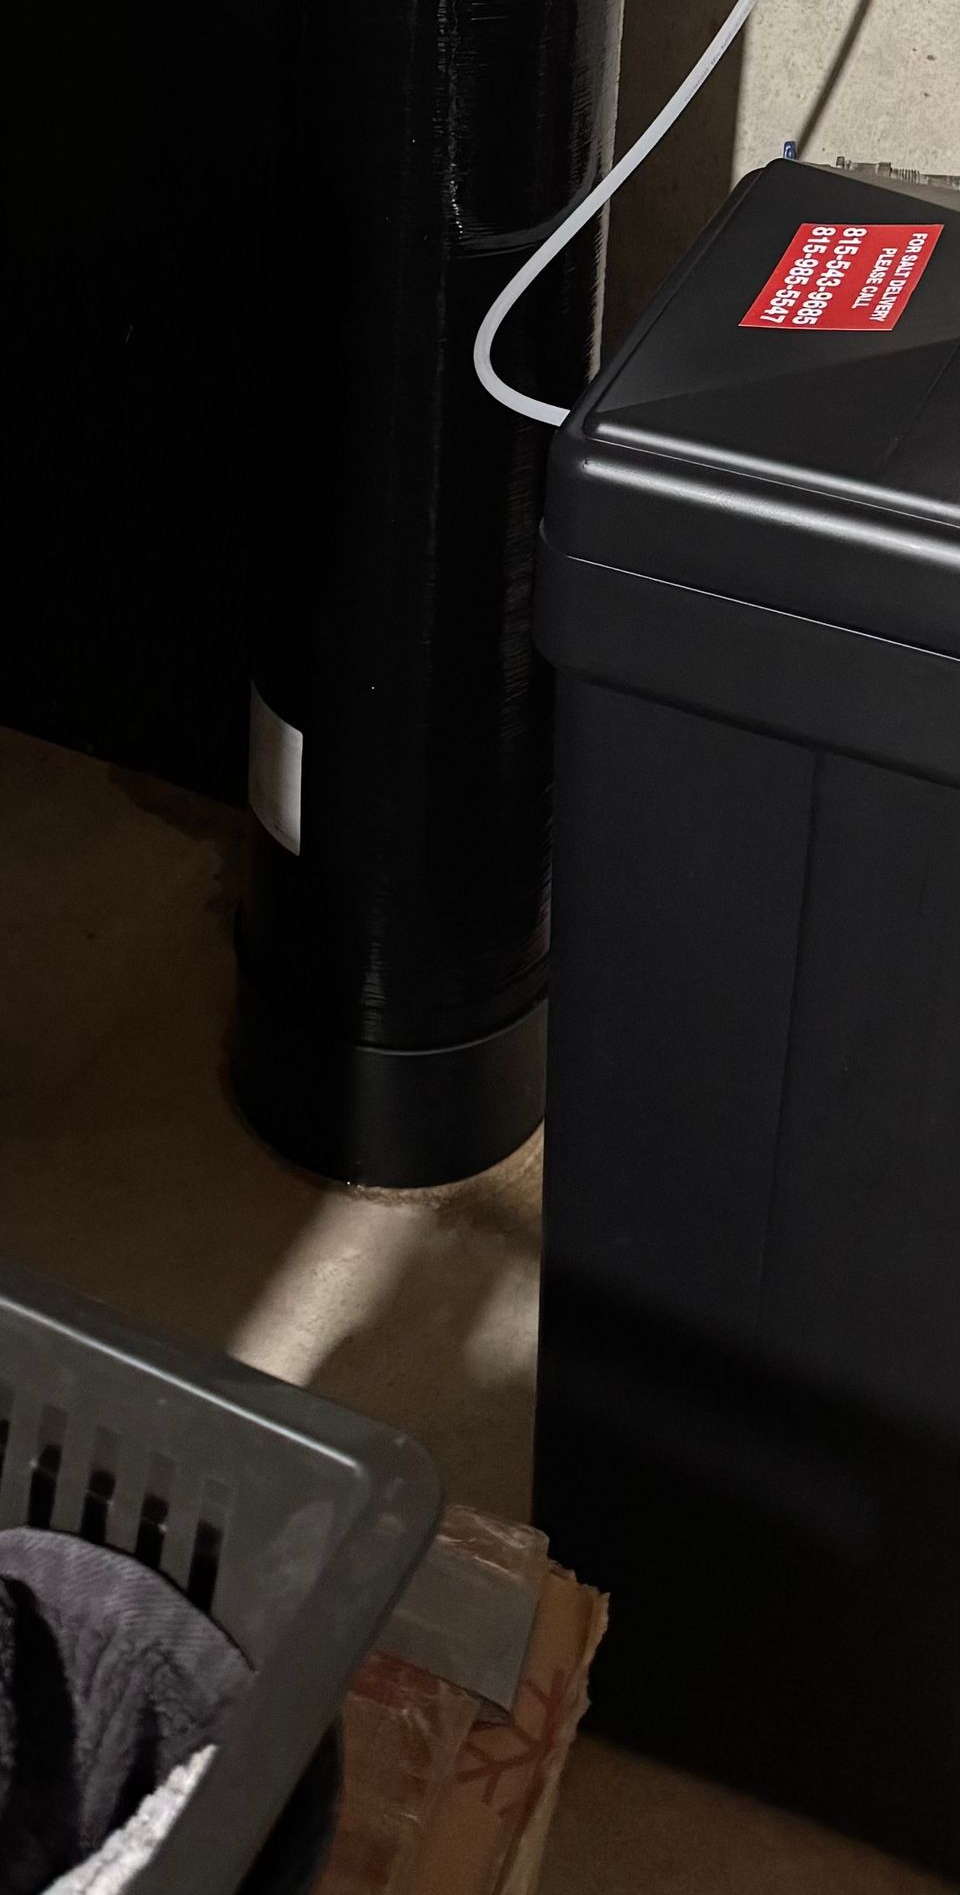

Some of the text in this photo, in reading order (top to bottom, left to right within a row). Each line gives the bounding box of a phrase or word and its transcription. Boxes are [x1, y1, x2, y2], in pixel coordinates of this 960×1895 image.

[759, 226, 836, 324] 815-985-5547
[792, 227, 867, 325] 815-543-9685
[851, 247, 898, 309] PLEASE CALL
[869, 232, 928, 322] FOR SALT DELIVERY
